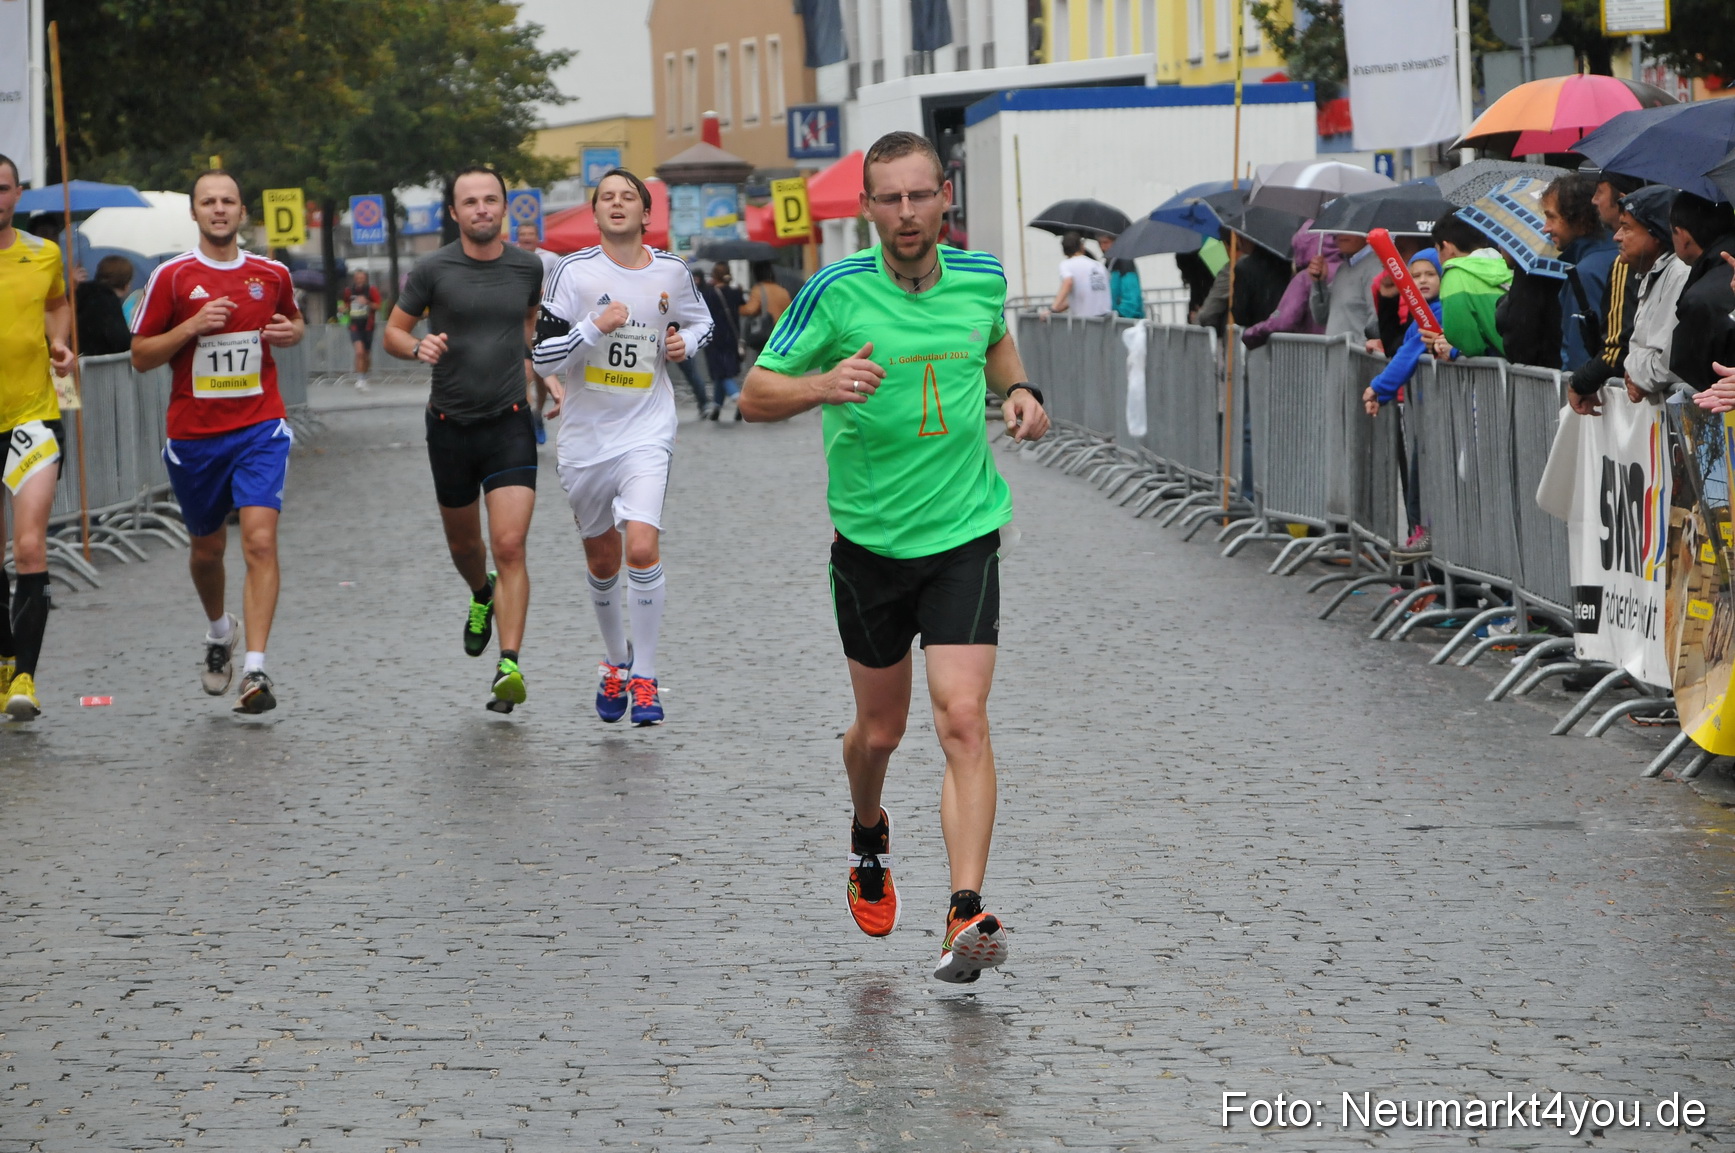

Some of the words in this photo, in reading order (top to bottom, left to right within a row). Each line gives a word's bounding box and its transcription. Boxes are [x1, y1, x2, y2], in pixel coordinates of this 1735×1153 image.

[793, 110, 836, 151] KL
[275, 206, 294, 233] D
[783, 196, 802, 223] D
[1404, 285, 1419, 306] BKK
[1416, 306, 1432, 328] Audi
[217, 339, 250, 347] Neumarkt
[615, 332, 648, 341] Neumarkt
[207, 348, 249, 372] 117
[608, 341, 638, 368] 65
[889, 357, 897, 365] 1.
[898, 352, 948, 364] Goldhutlauf
[949, 351, 969, 360] 2012
[210, 377, 248, 388] Dominik
[604, 372, 634, 386] Felipe
[20, 451, 42, 473] Lucas
